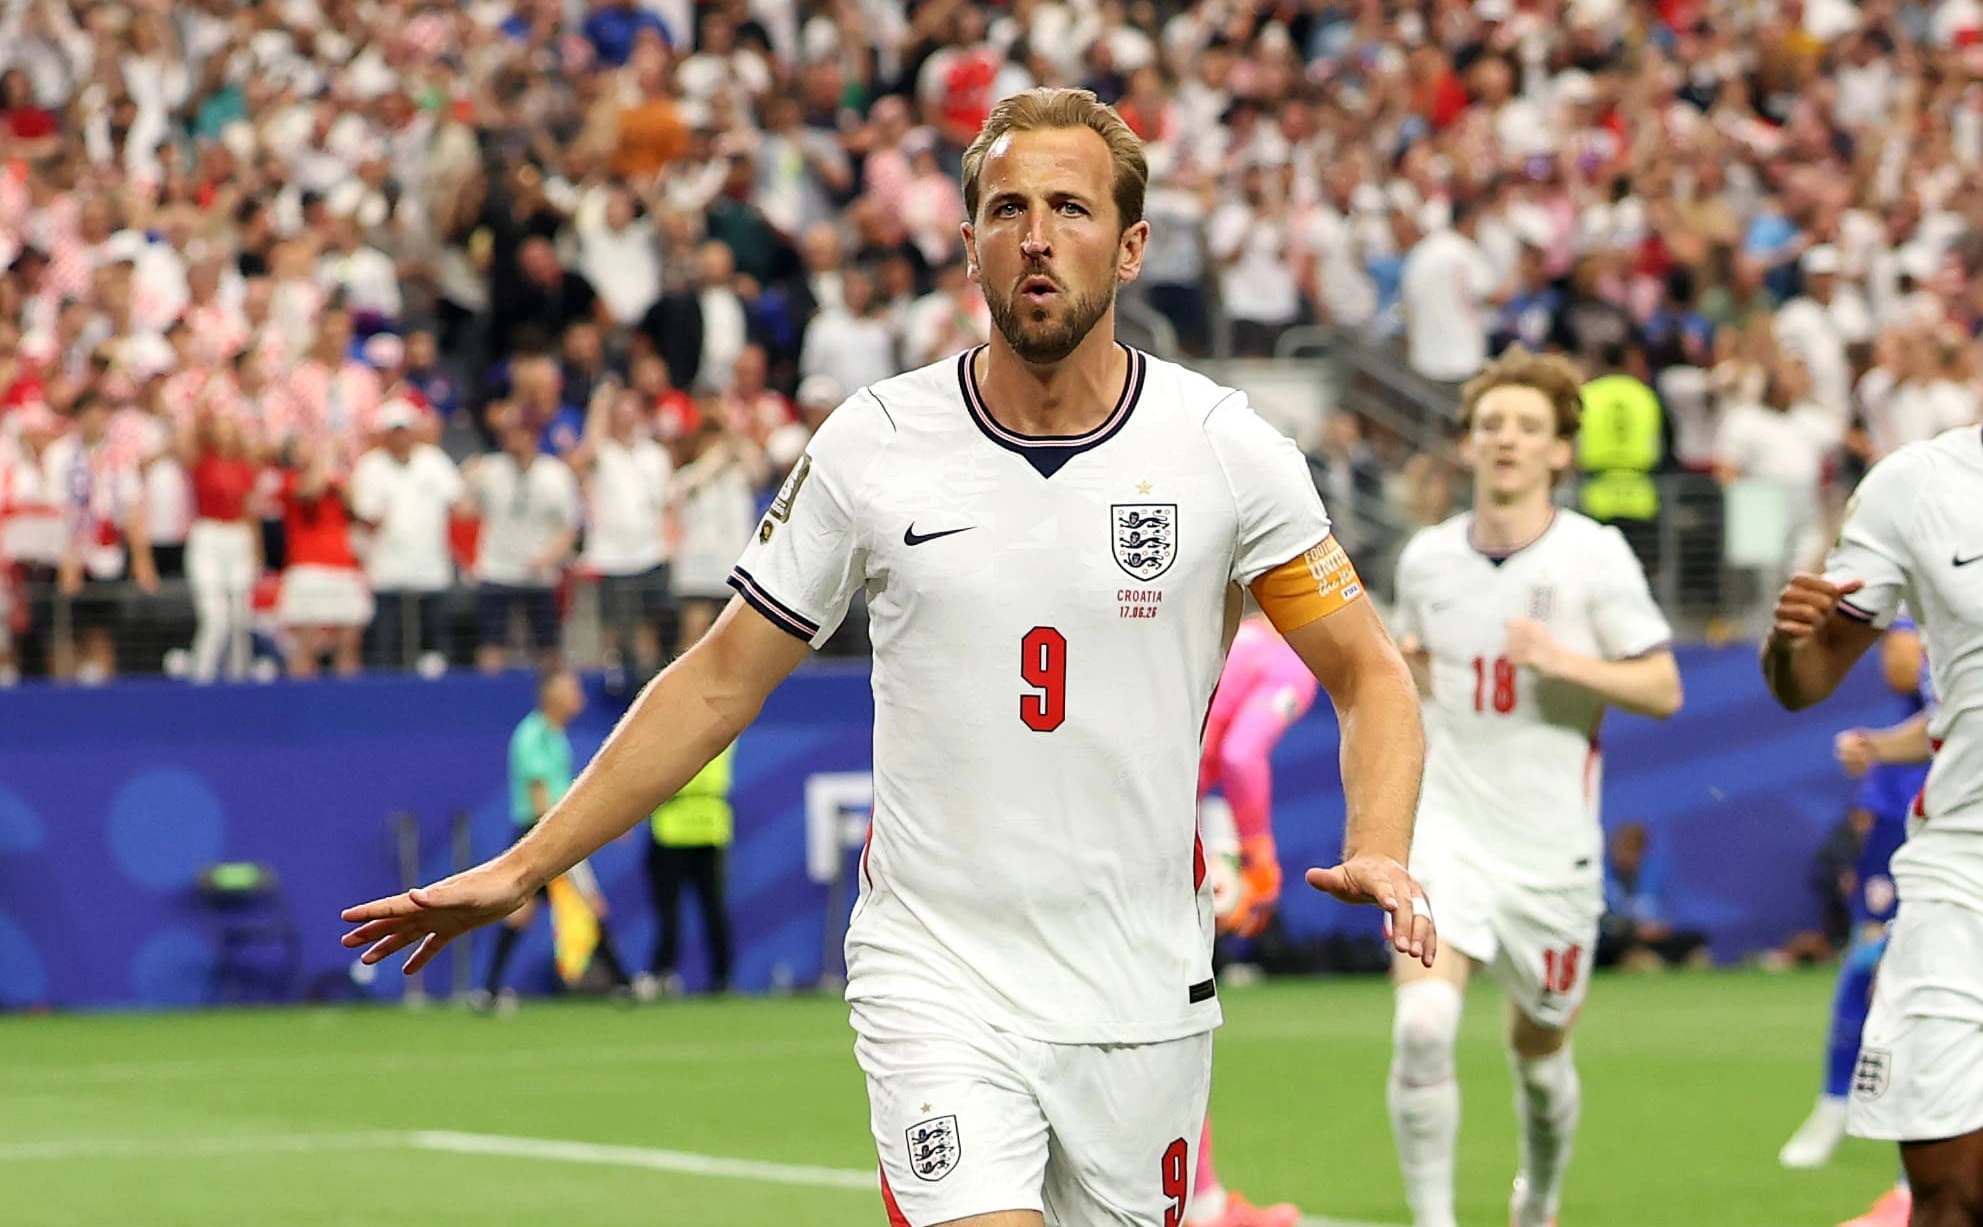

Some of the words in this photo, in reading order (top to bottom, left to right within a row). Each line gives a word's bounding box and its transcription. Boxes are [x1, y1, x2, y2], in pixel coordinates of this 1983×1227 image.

[1117, 589, 1162, 602] CROATIA
[1120, 606, 1157, 618] 17.06.26
[1020, 626, 1067, 732] 9
[1472, 656, 1515, 713] 18
[1162, 1137, 1188, 1227] 9
